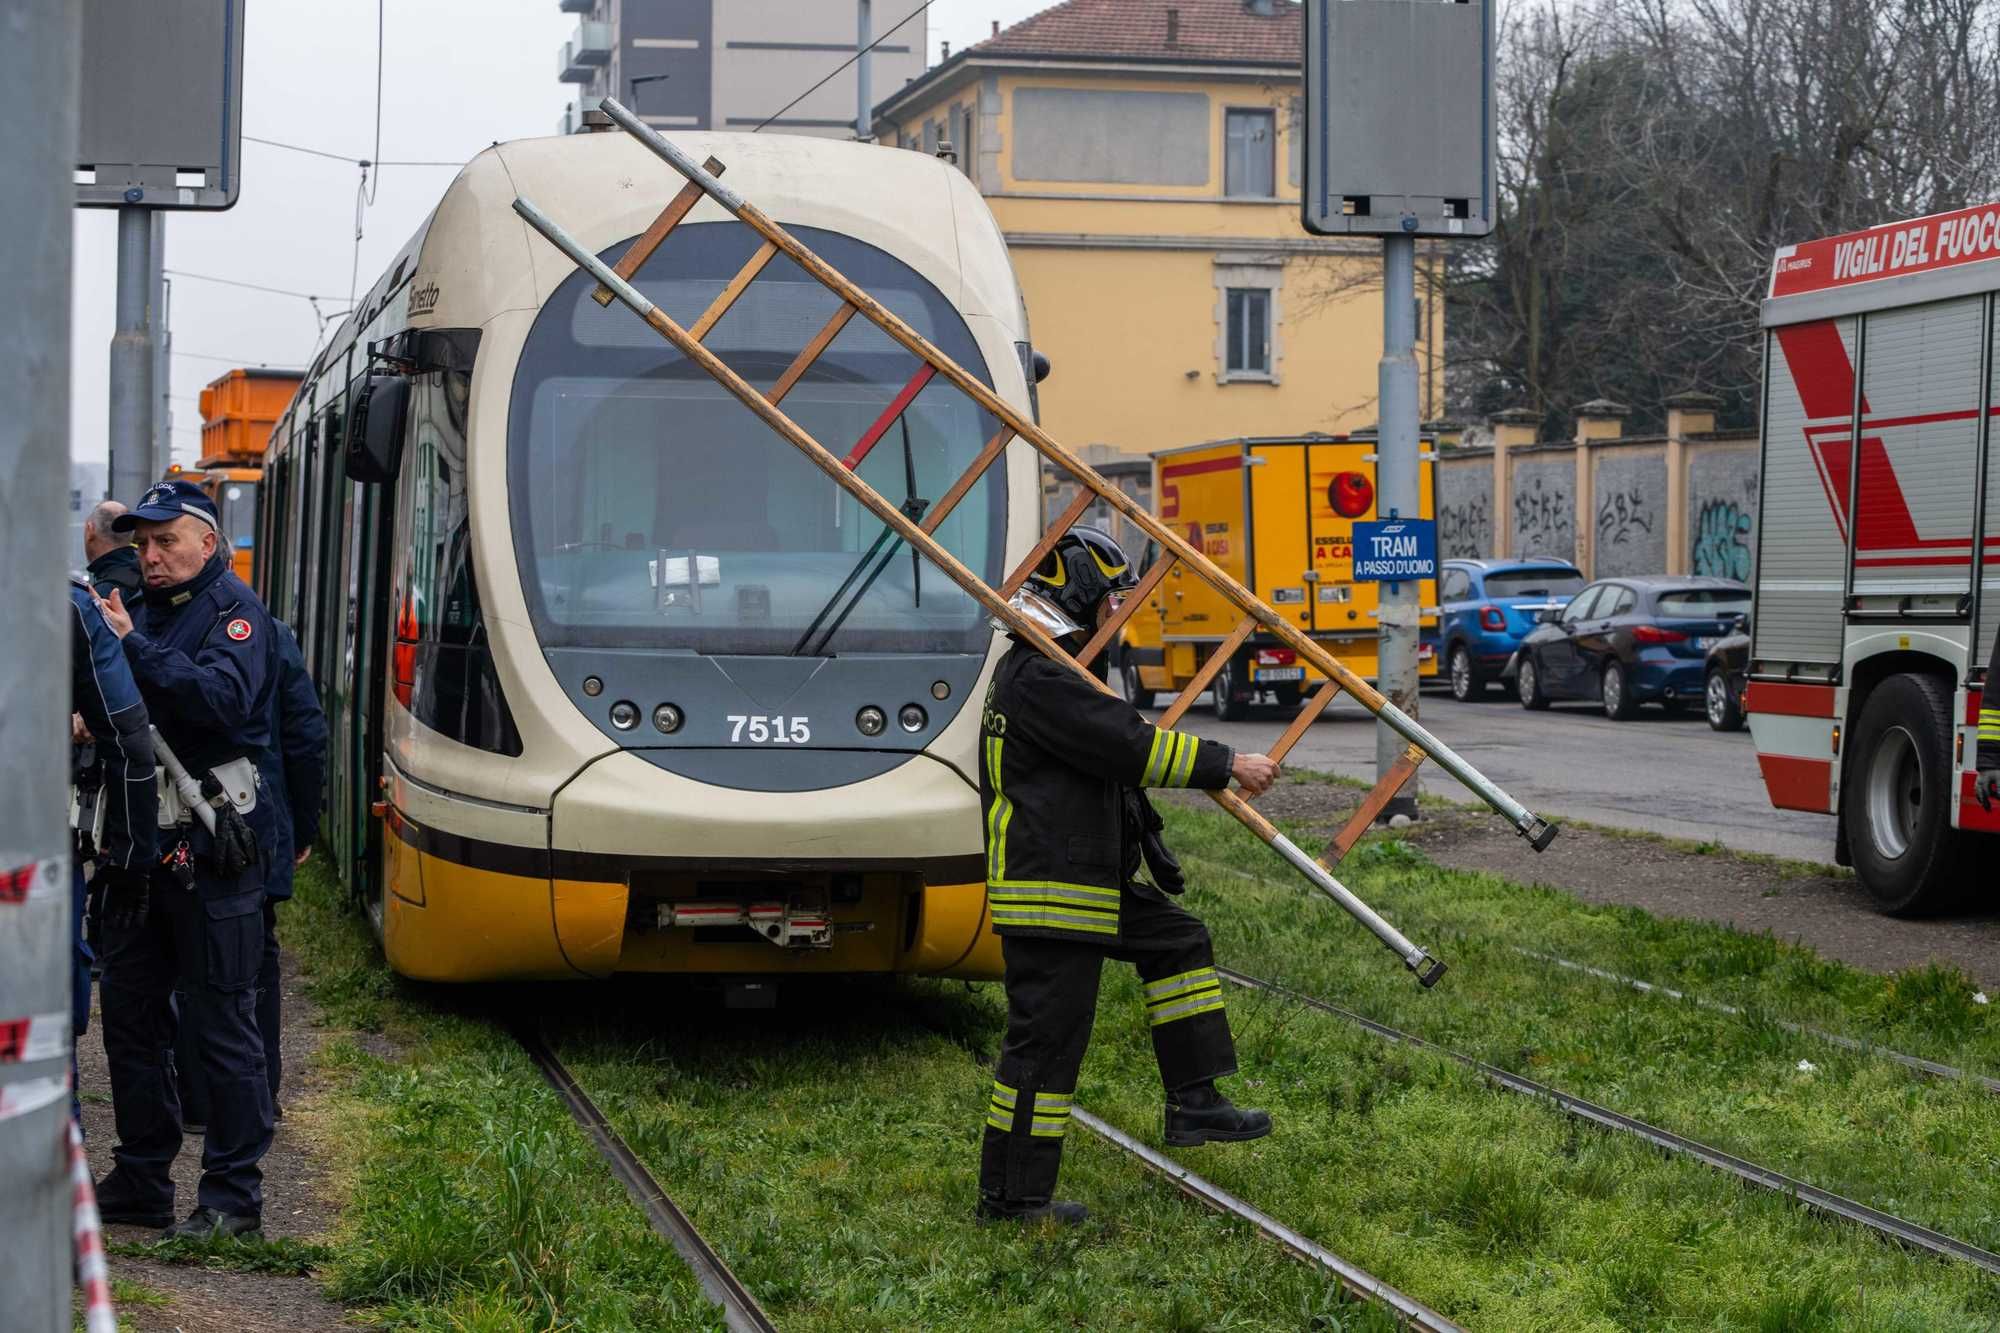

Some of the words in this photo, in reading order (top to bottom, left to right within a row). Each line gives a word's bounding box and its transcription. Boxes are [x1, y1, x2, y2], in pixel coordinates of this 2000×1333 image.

[1833, 233, 1889, 280] VIGILI
[1890, 225, 1929, 270] DEL
[1316, 546, 1326, 558] A
[1370, 536, 1417, 558] TRAM
[1355, 561, 1363, 575] A
[1364, 560, 1395, 575] PASSO
[1396, 559, 1434, 575] D'UOMO
[726, 715, 811, 744] 7515
